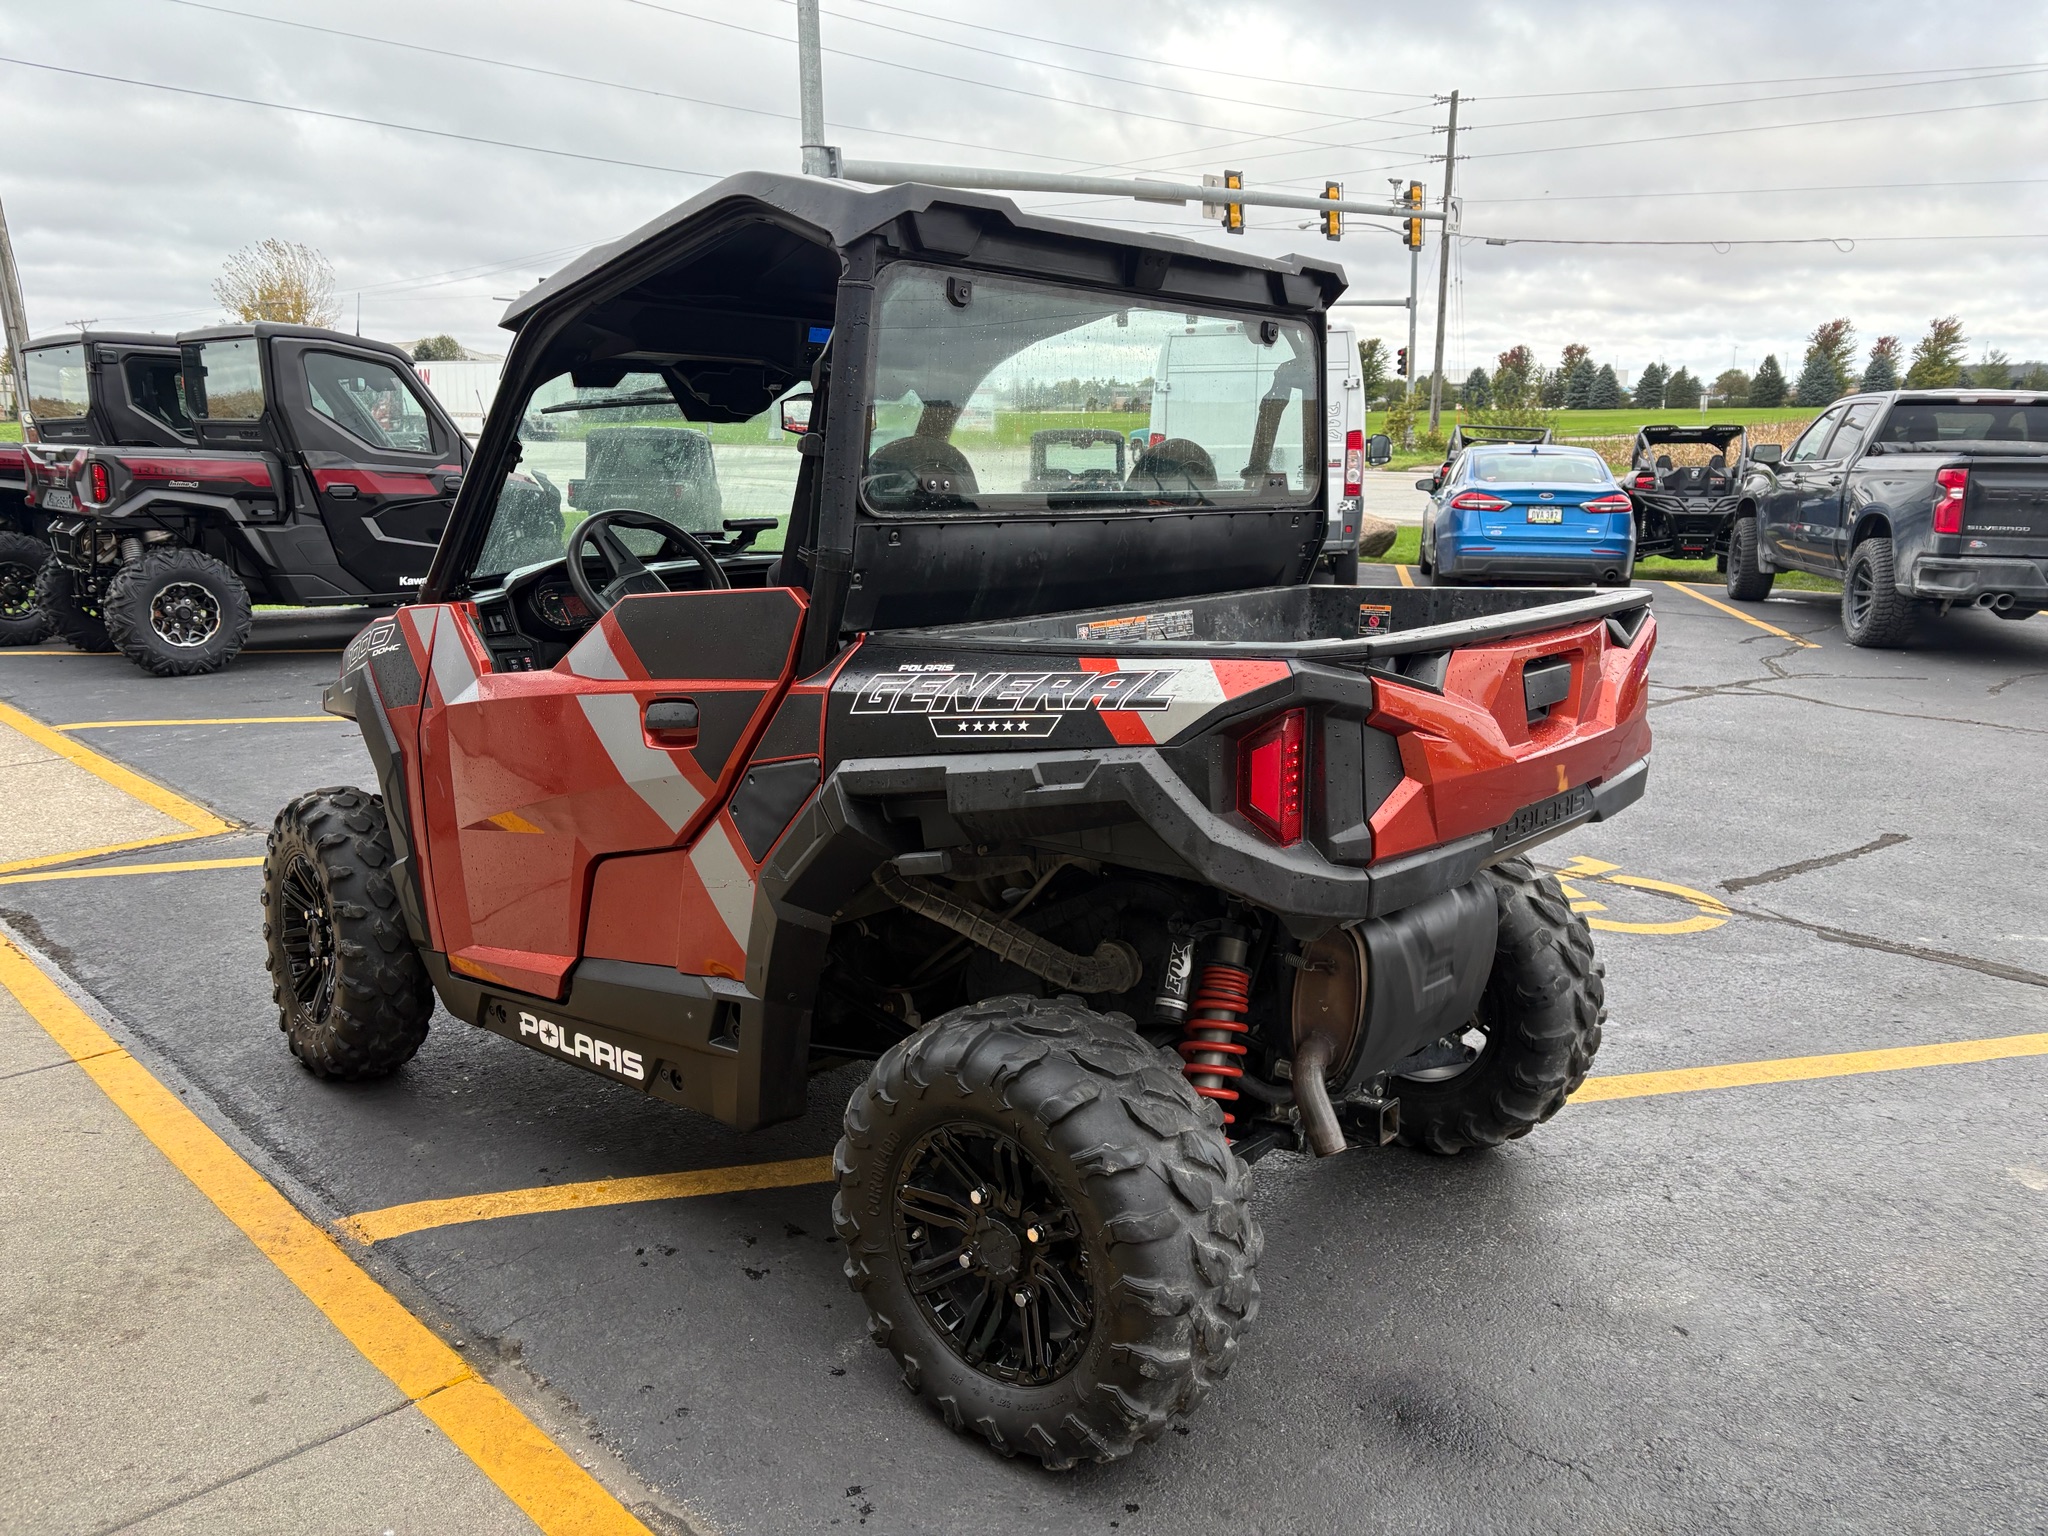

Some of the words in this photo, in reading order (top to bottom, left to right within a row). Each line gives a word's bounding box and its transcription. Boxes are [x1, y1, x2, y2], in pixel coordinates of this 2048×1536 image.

[371, 643, 402, 657] DOHC
[898, 663, 955, 672] POLARIS
[850, 669, 1183, 714] GENERAL
[1503, 788, 1585, 844] POLARIS
[1165, 942, 1192, 995] FOX
[518, 1011, 645, 1081] POLARIS
